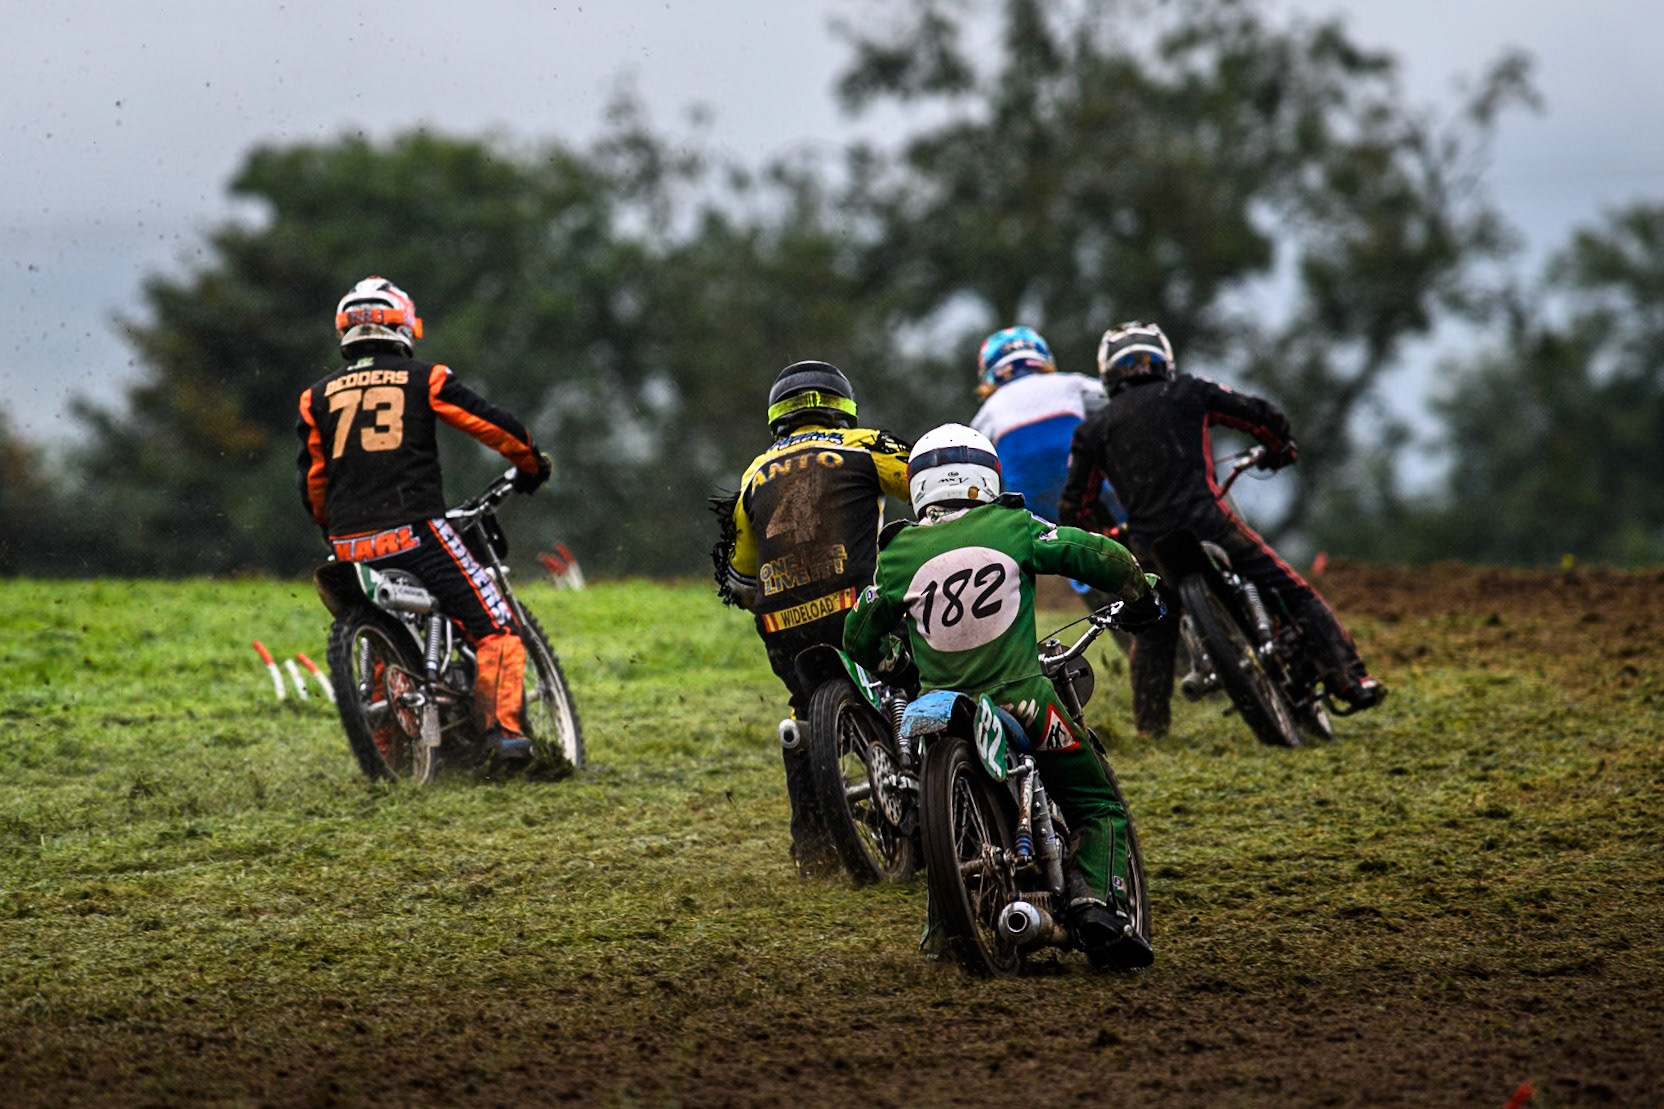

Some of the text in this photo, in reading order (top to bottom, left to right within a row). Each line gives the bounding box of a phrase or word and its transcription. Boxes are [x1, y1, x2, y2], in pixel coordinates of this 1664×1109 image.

[328, 386, 405, 459] 73
[751, 451, 845, 497] ANTO
[760, 553, 799, 581] ONE
[764, 569, 812, 597] LIVE
[781, 597, 834, 627] WIDELOAD
[920, 563, 1006, 634] 182
